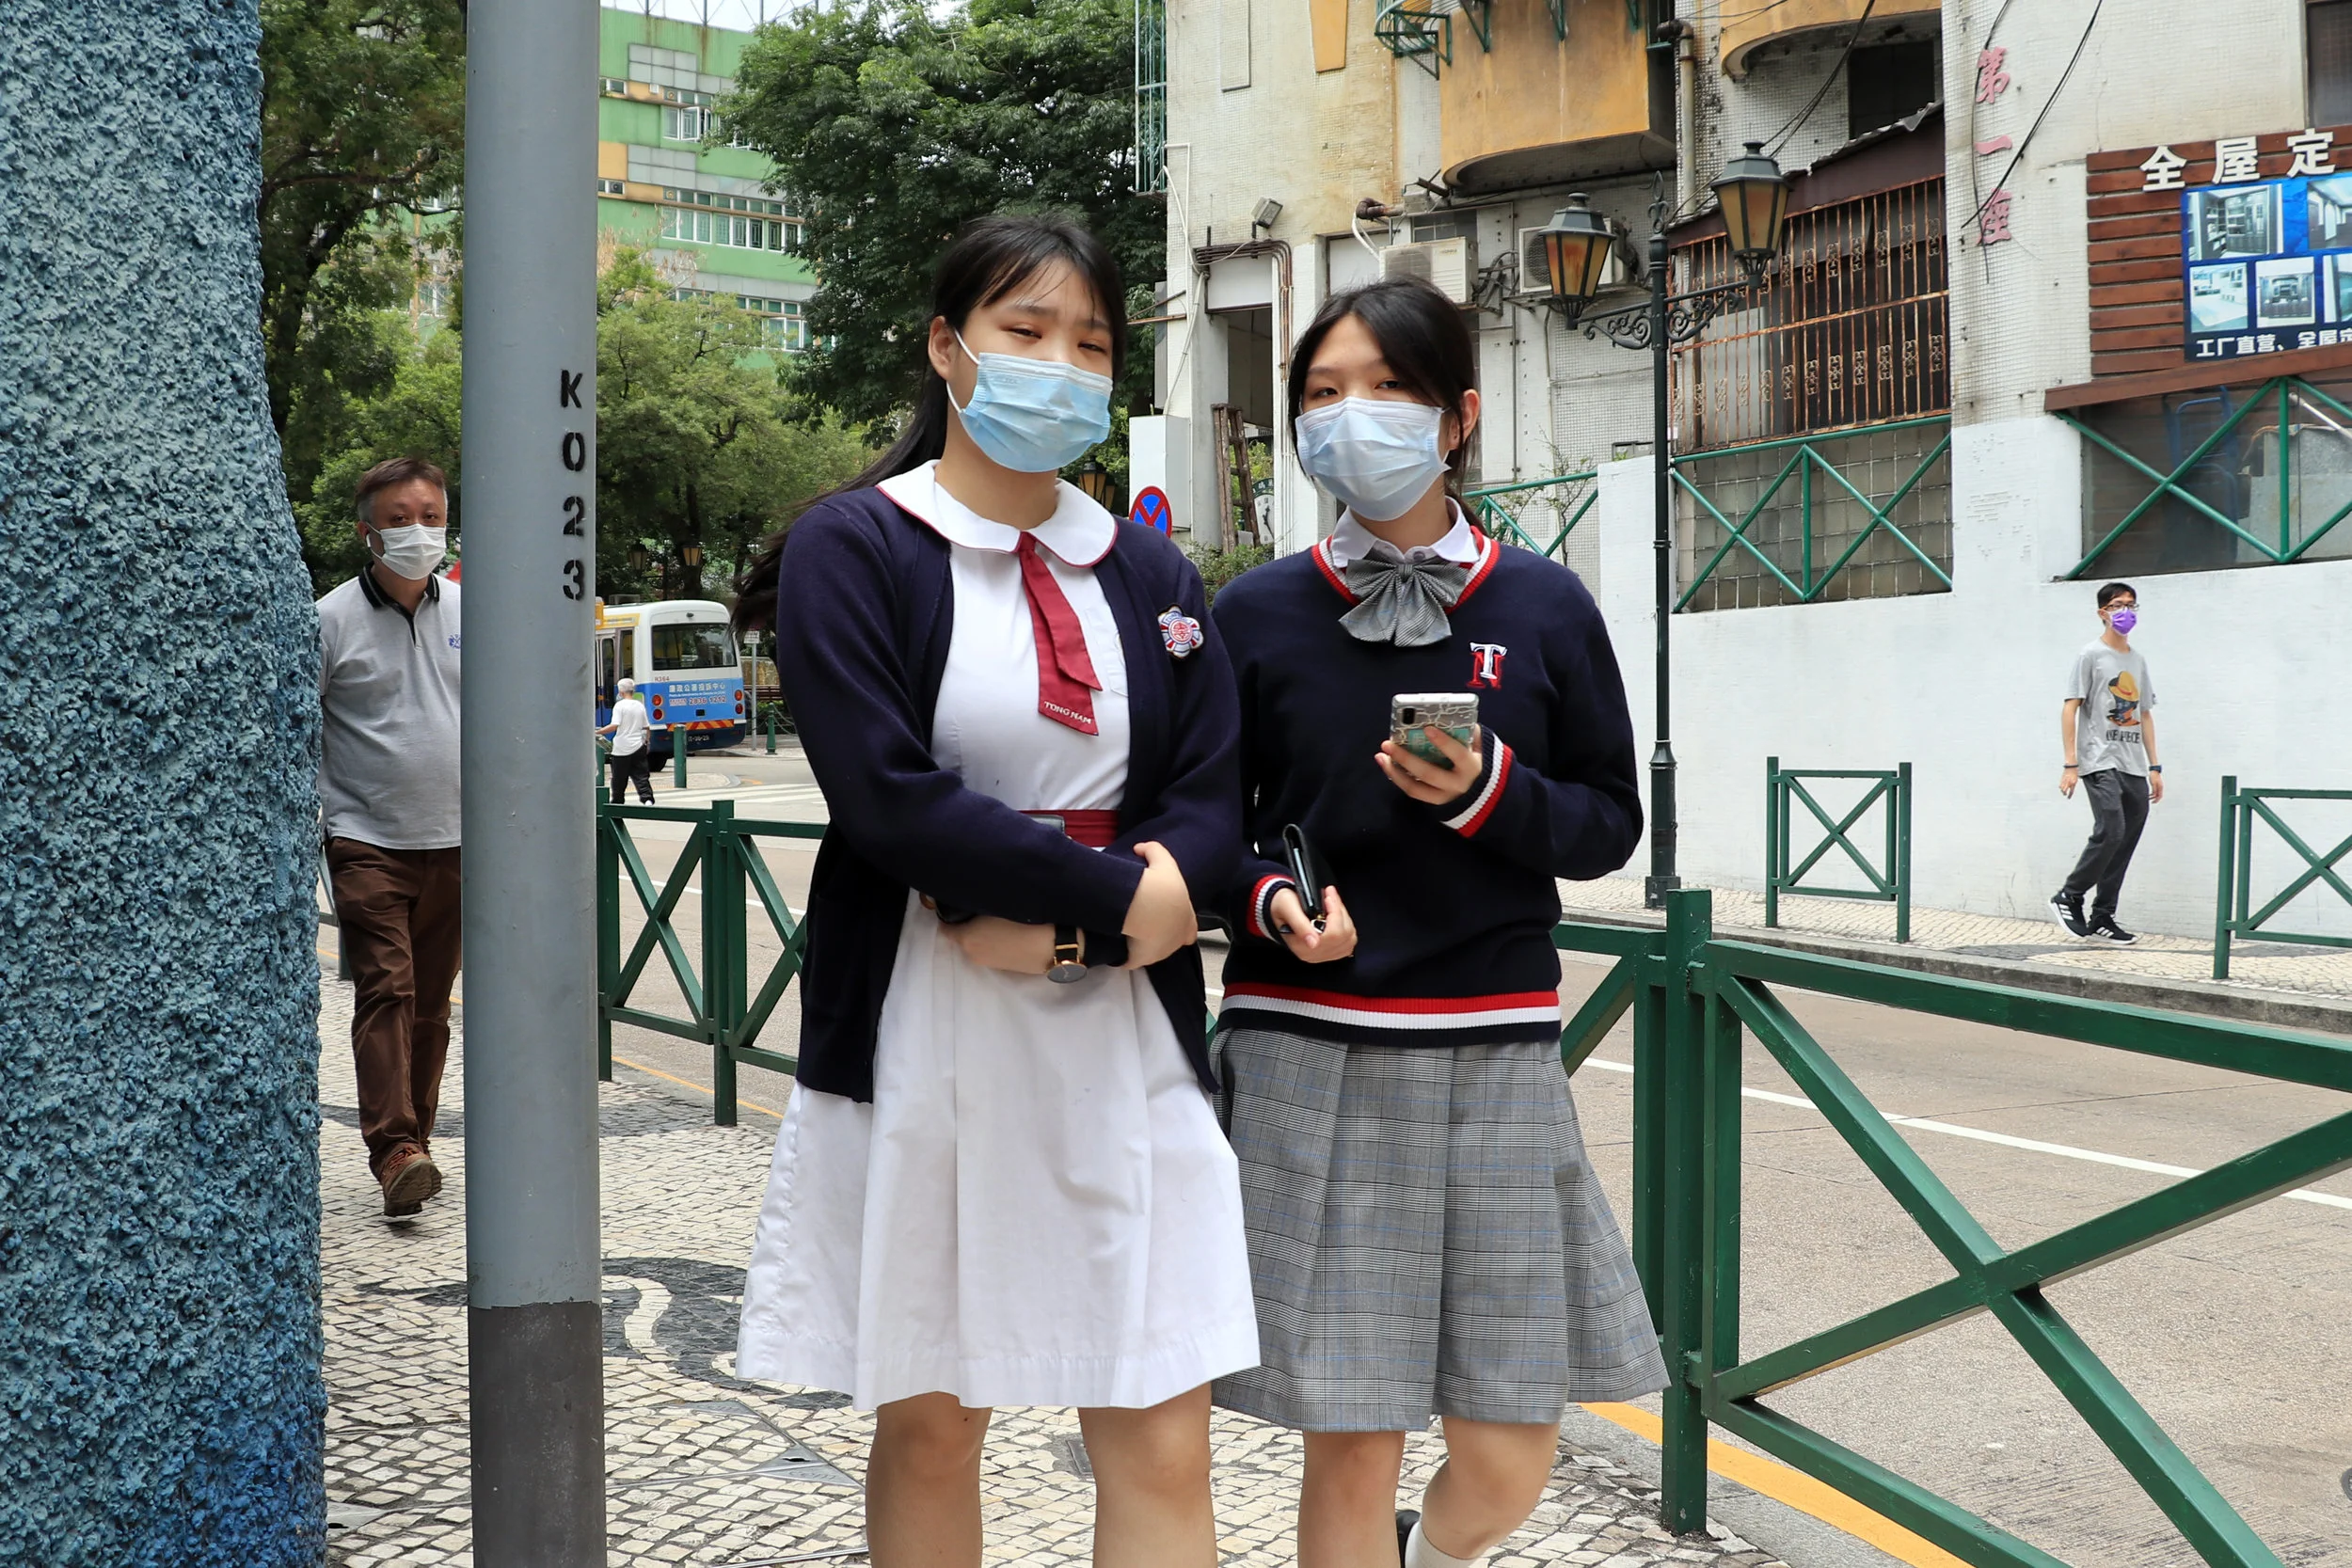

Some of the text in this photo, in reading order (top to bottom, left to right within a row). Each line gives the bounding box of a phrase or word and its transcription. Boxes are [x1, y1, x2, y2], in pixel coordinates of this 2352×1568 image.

[1976, 47, 2013, 246] 第一座
[2139, 128, 2337, 192] 全屋定
[560, 370, 585, 601] K023
[1044, 701, 1092, 724] TONG NAM
